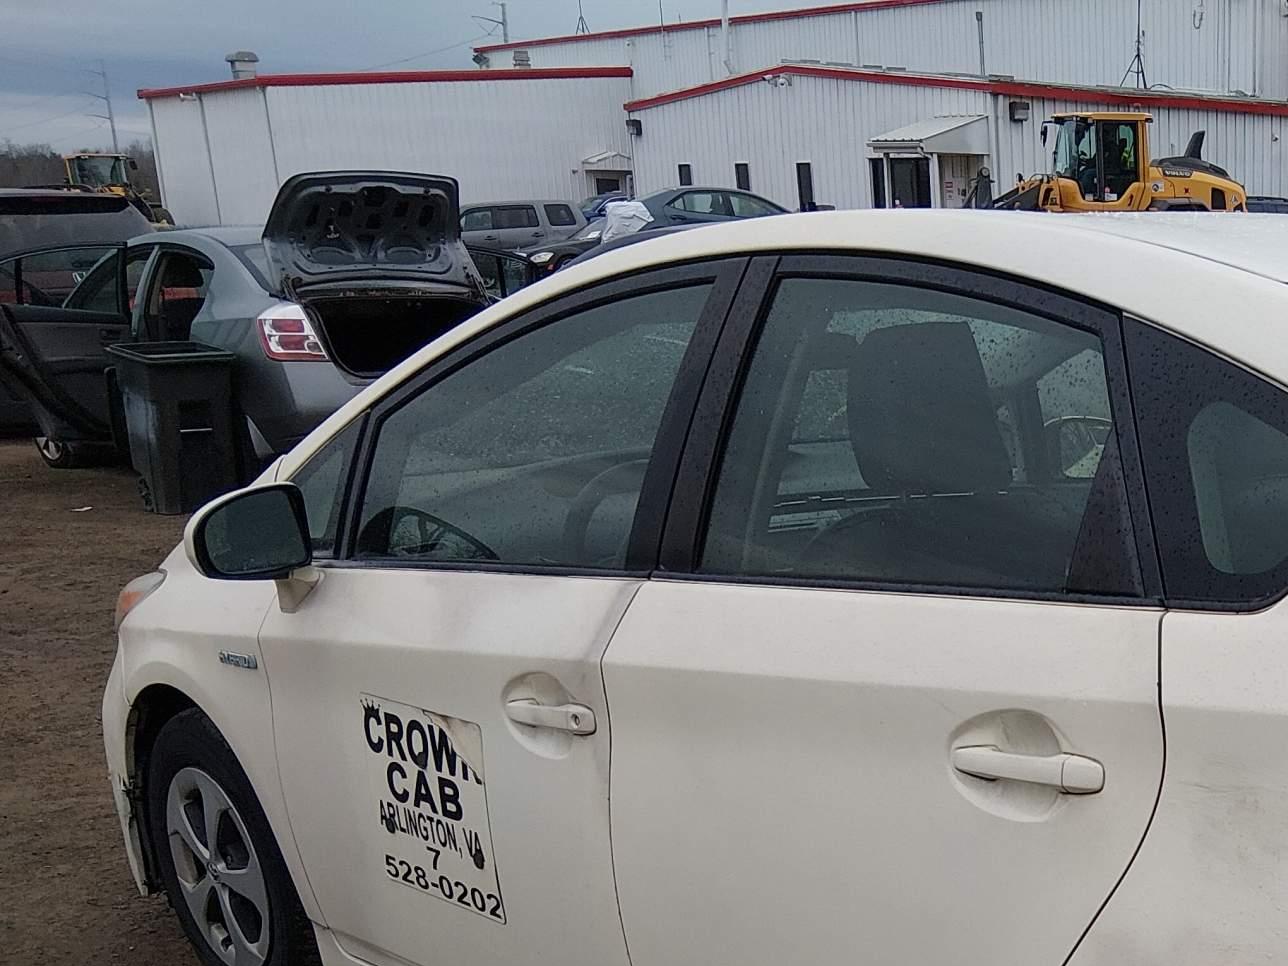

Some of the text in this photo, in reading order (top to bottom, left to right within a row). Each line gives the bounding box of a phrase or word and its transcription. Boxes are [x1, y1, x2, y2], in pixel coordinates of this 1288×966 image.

[386, 761, 464, 822] CAB
[379, 799, 464, 860] ARLINGTON,
[426, 846, 441, 871] 7
[385, 854, 504, 920] 528-0202
